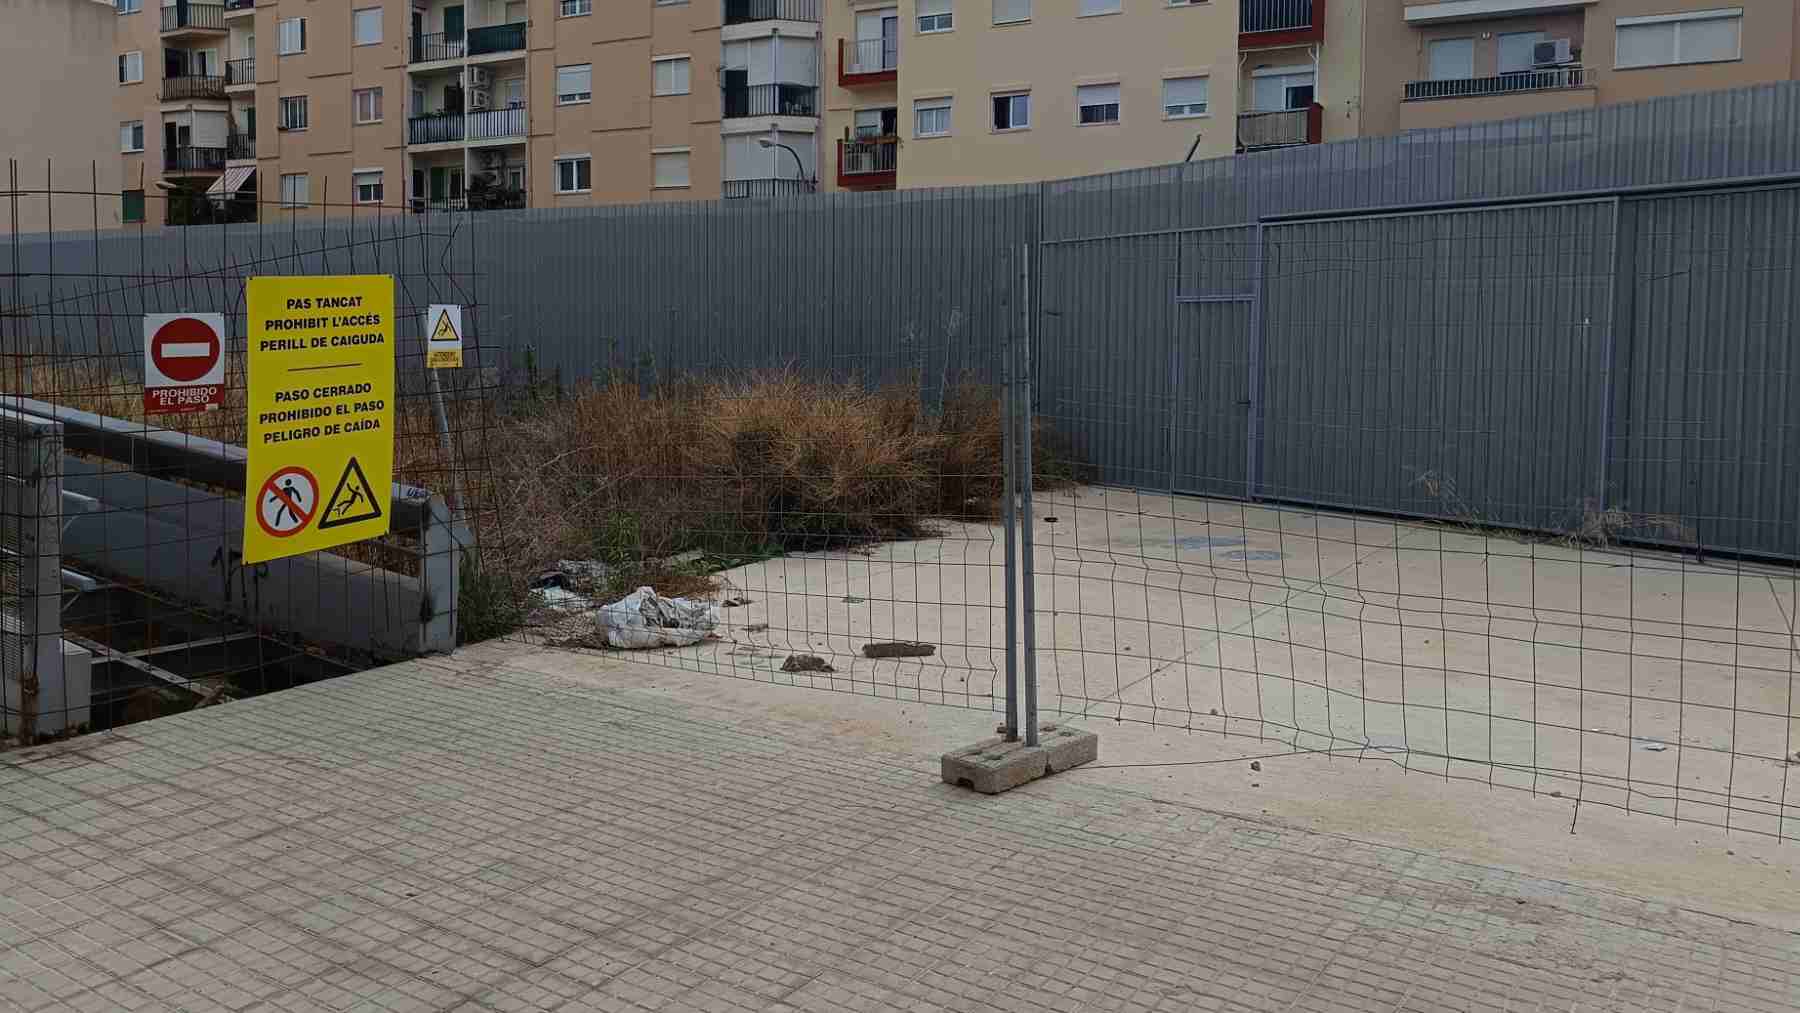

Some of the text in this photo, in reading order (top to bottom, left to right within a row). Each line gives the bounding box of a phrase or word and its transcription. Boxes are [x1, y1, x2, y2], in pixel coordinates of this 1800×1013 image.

[287, 296, 362, 309] PAS TANCAT
[265, 312, 380, 331] PROHIBIT L'ACCÉS
[260, 333, 384, 351] PERILL DE CAIGUDA
[152, 386, 217, 398] PROHIBIDO
[160, 395, 209, 405] EL PASO
[275, 383, 371, 402] PASO CERRADO
[259, 400, 384, 424] PROHIBIDO EL PASO
[264, 419, 380, 444] PELIGRO DE CAÍDA
